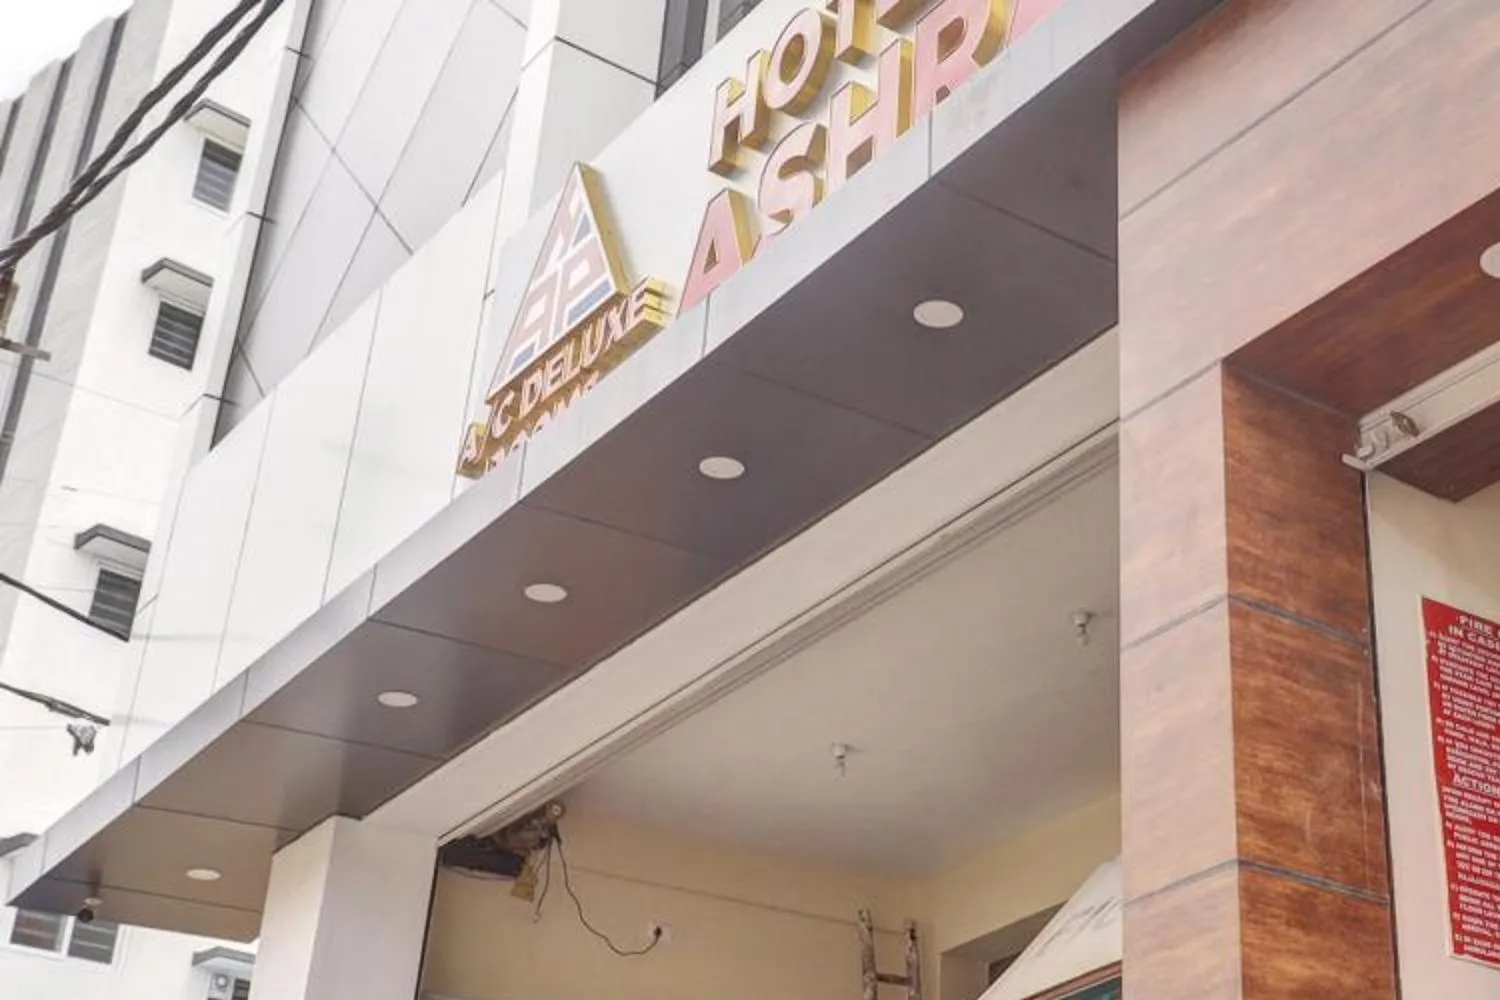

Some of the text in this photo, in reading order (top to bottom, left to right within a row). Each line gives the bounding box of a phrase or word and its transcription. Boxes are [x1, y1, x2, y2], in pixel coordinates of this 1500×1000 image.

[680, 0, 1066, 310] ASHR
[708, 0, 938, 176] HOT
[518, 275, 657, 421] DELUXE
[1448, 623, 1464, 638] IN
[1452, 773, 1500, 799] ACTION
